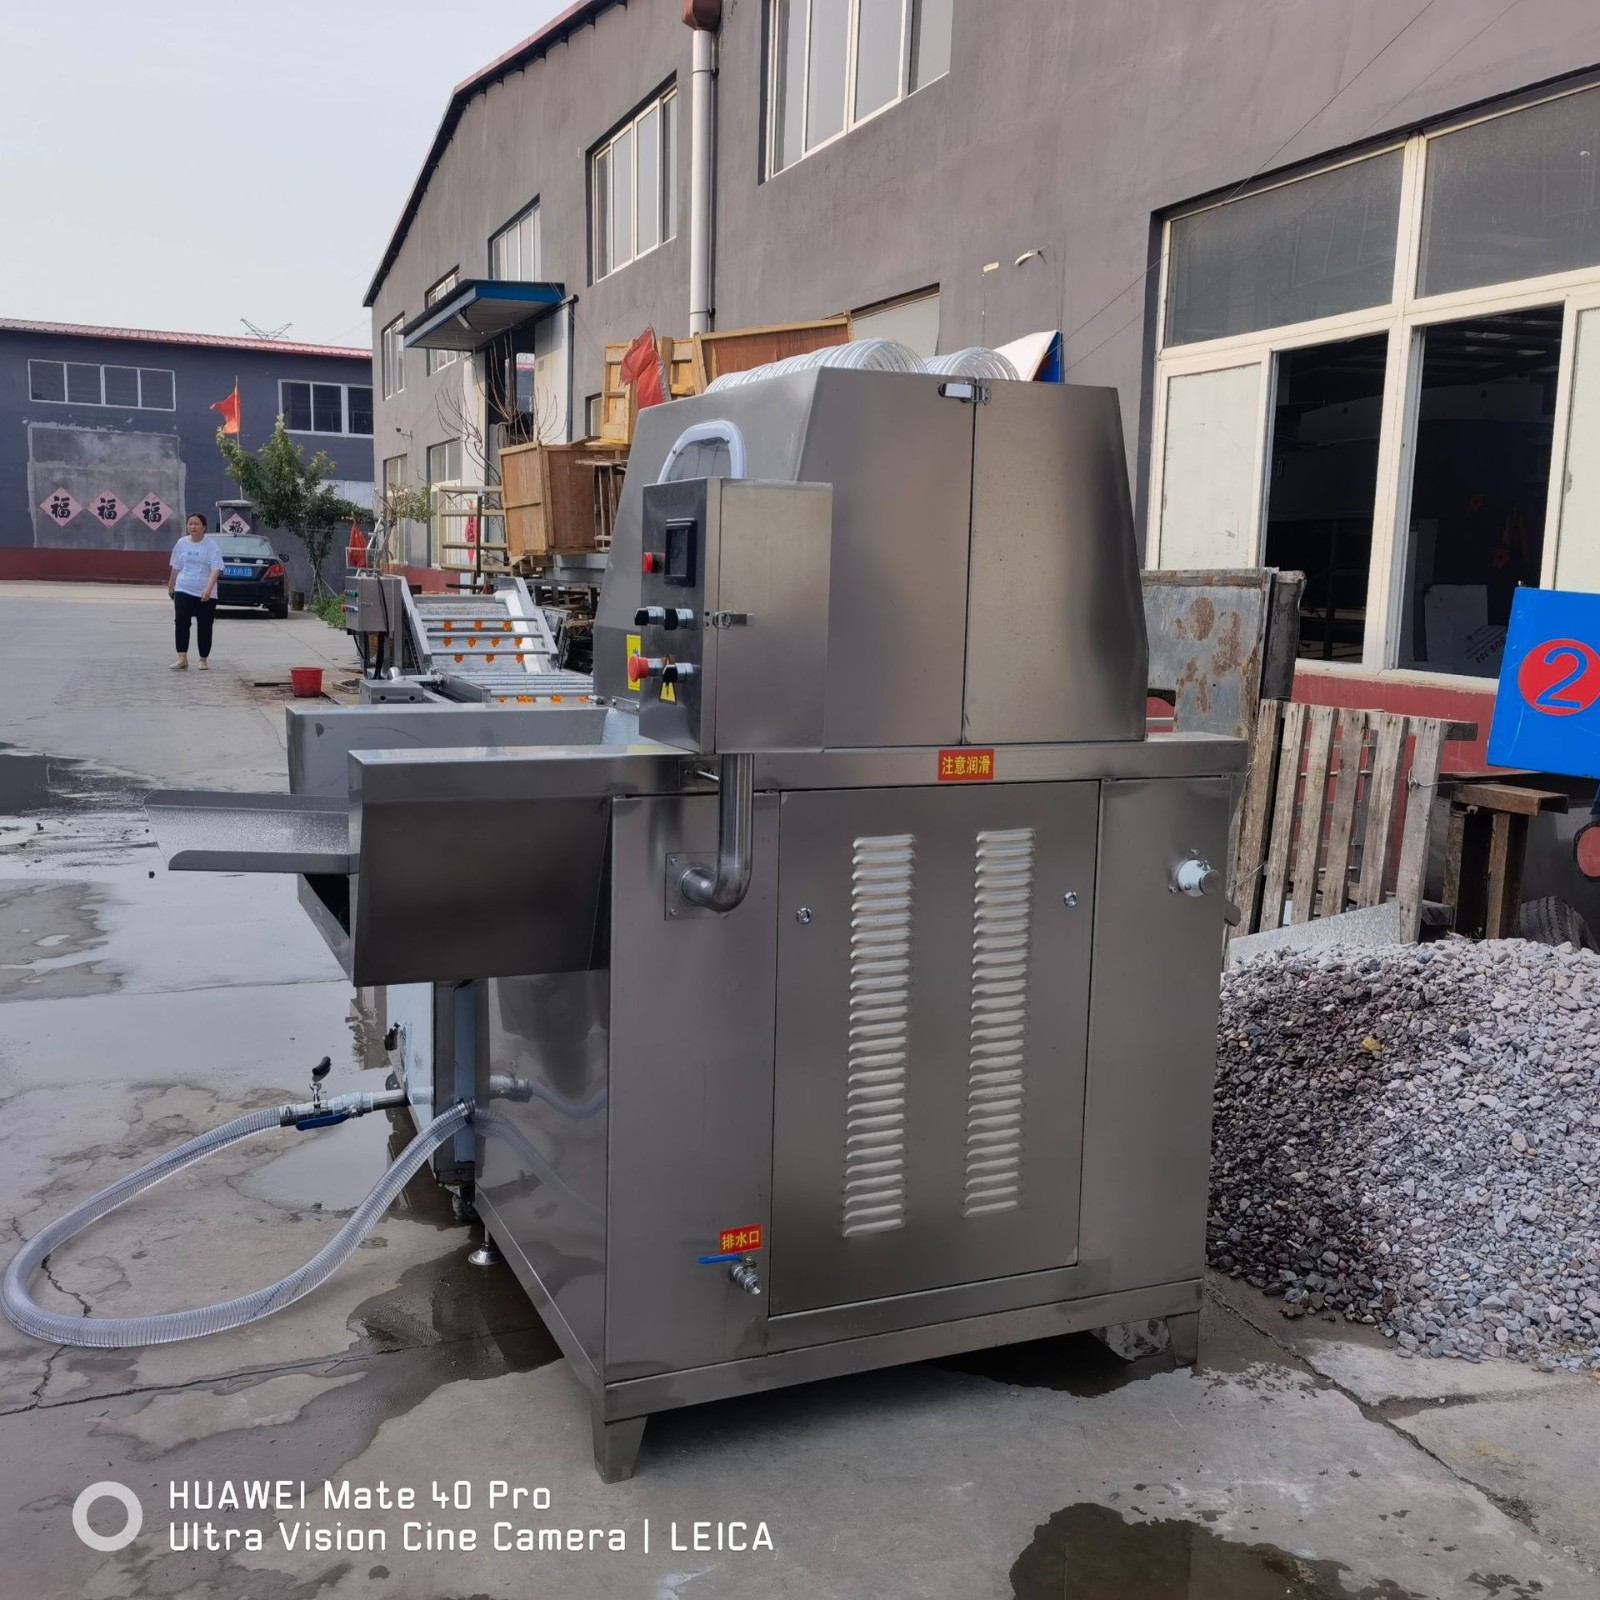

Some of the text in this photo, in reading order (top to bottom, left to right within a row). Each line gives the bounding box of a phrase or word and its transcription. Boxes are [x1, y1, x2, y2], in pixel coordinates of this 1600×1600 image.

[50, 495, 71, 518] 福
[97, 497, 117, 520] 福
[142, 501, 162, 523] 福
[229, 520, 243, 533] 福
[1535, 646, 1588, 709] 2
[942, 755, 990, 775] 注意润滑
[722, 1230, 759, 1250] 排水口
